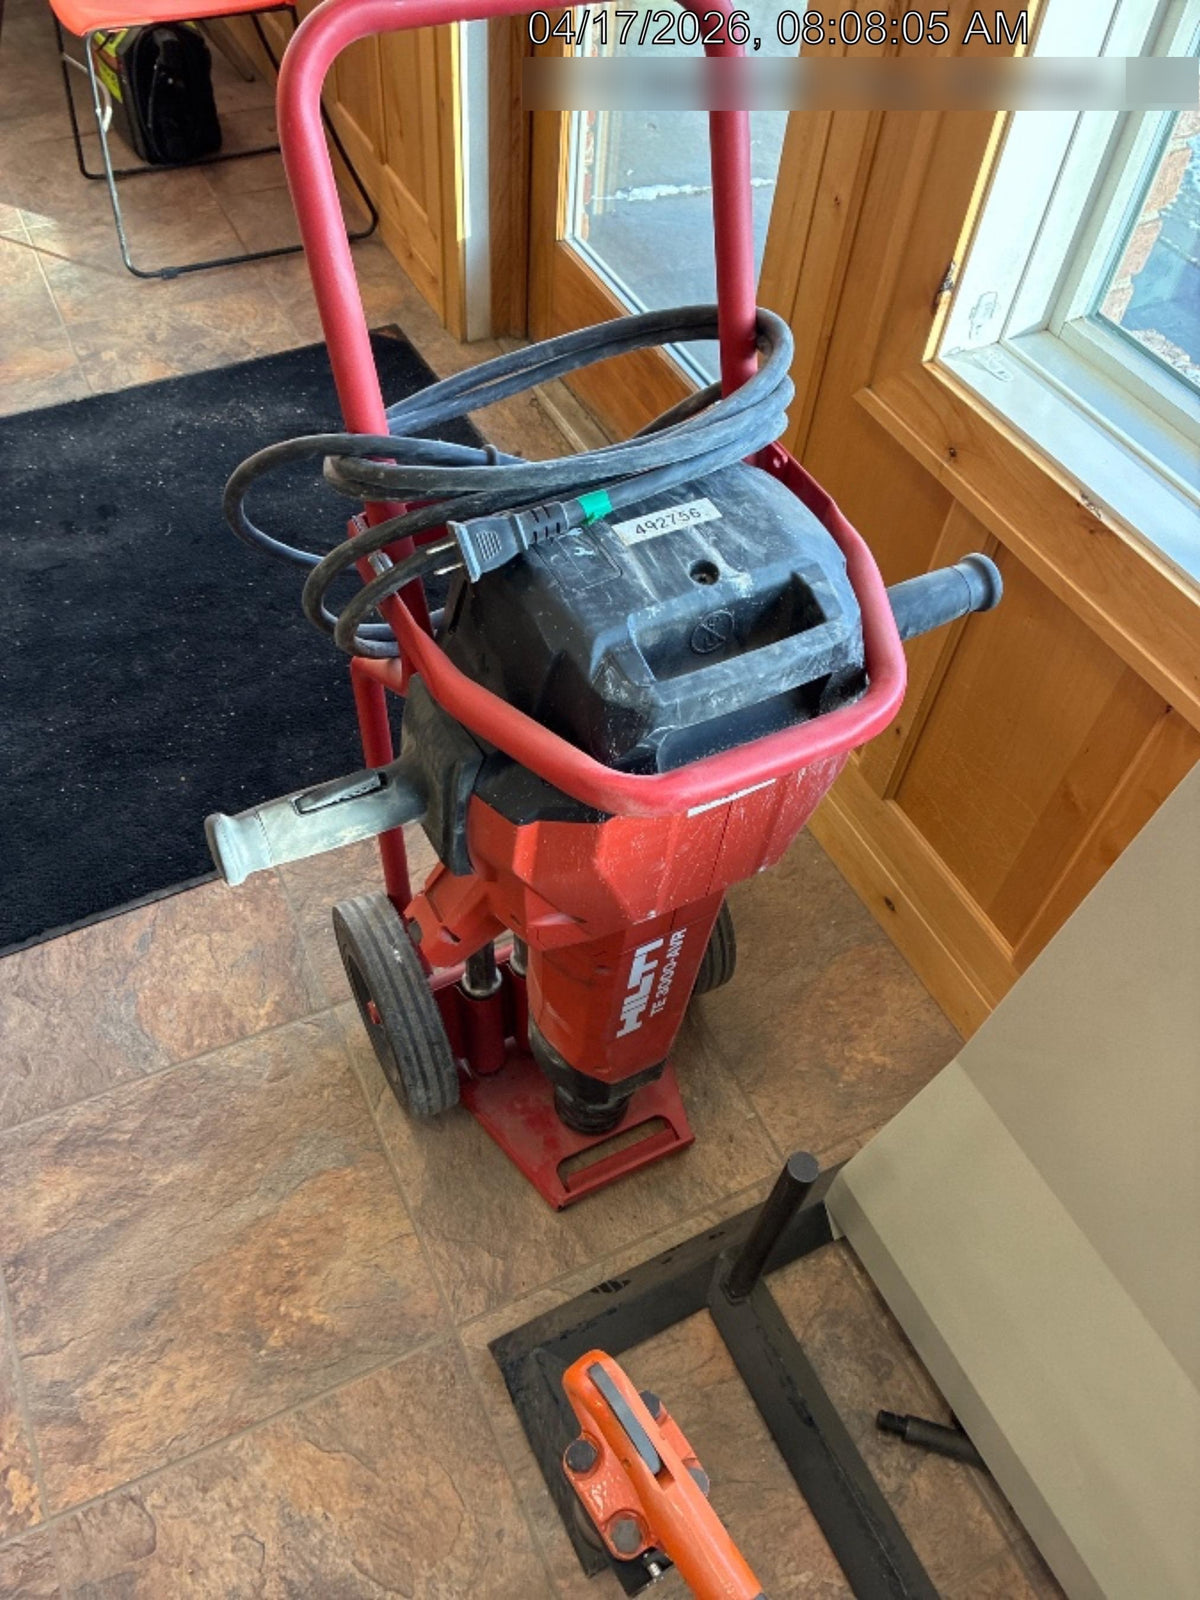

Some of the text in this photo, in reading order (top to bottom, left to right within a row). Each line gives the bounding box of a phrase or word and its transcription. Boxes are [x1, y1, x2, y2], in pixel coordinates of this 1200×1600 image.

[635, 507, 701, 535] 492756
[616, 938, 664, 1038] HILTI
[649, 927, 687, 1017] TE 3000-AVR
